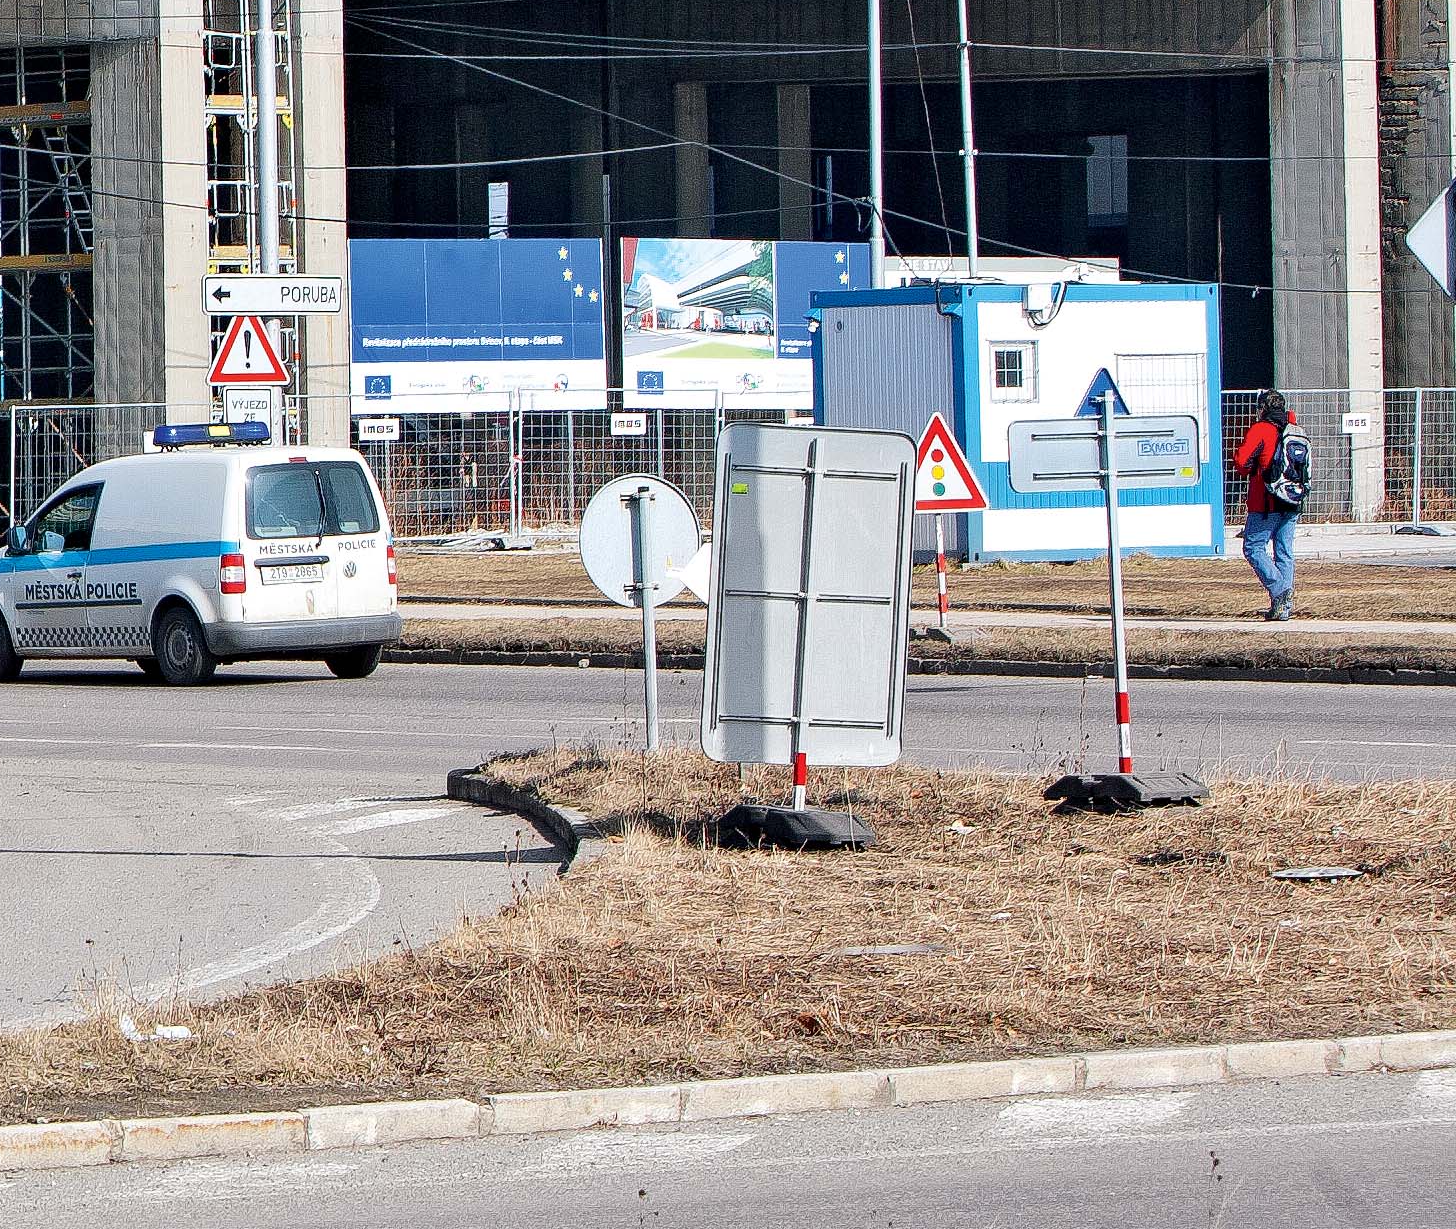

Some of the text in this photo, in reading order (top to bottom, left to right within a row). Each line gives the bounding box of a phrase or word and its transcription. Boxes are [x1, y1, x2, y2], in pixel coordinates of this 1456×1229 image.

[280, 285, 337, 304] PORUBA
[1141, 442, 1186, 453] EXMOST
[259, 539, 377, 555] MĚSTSKÁ POLICIE
[270, 567, 288, 579] 2T9
[25, 580, 138, 600] MĚSTSKÁ POLICIE
